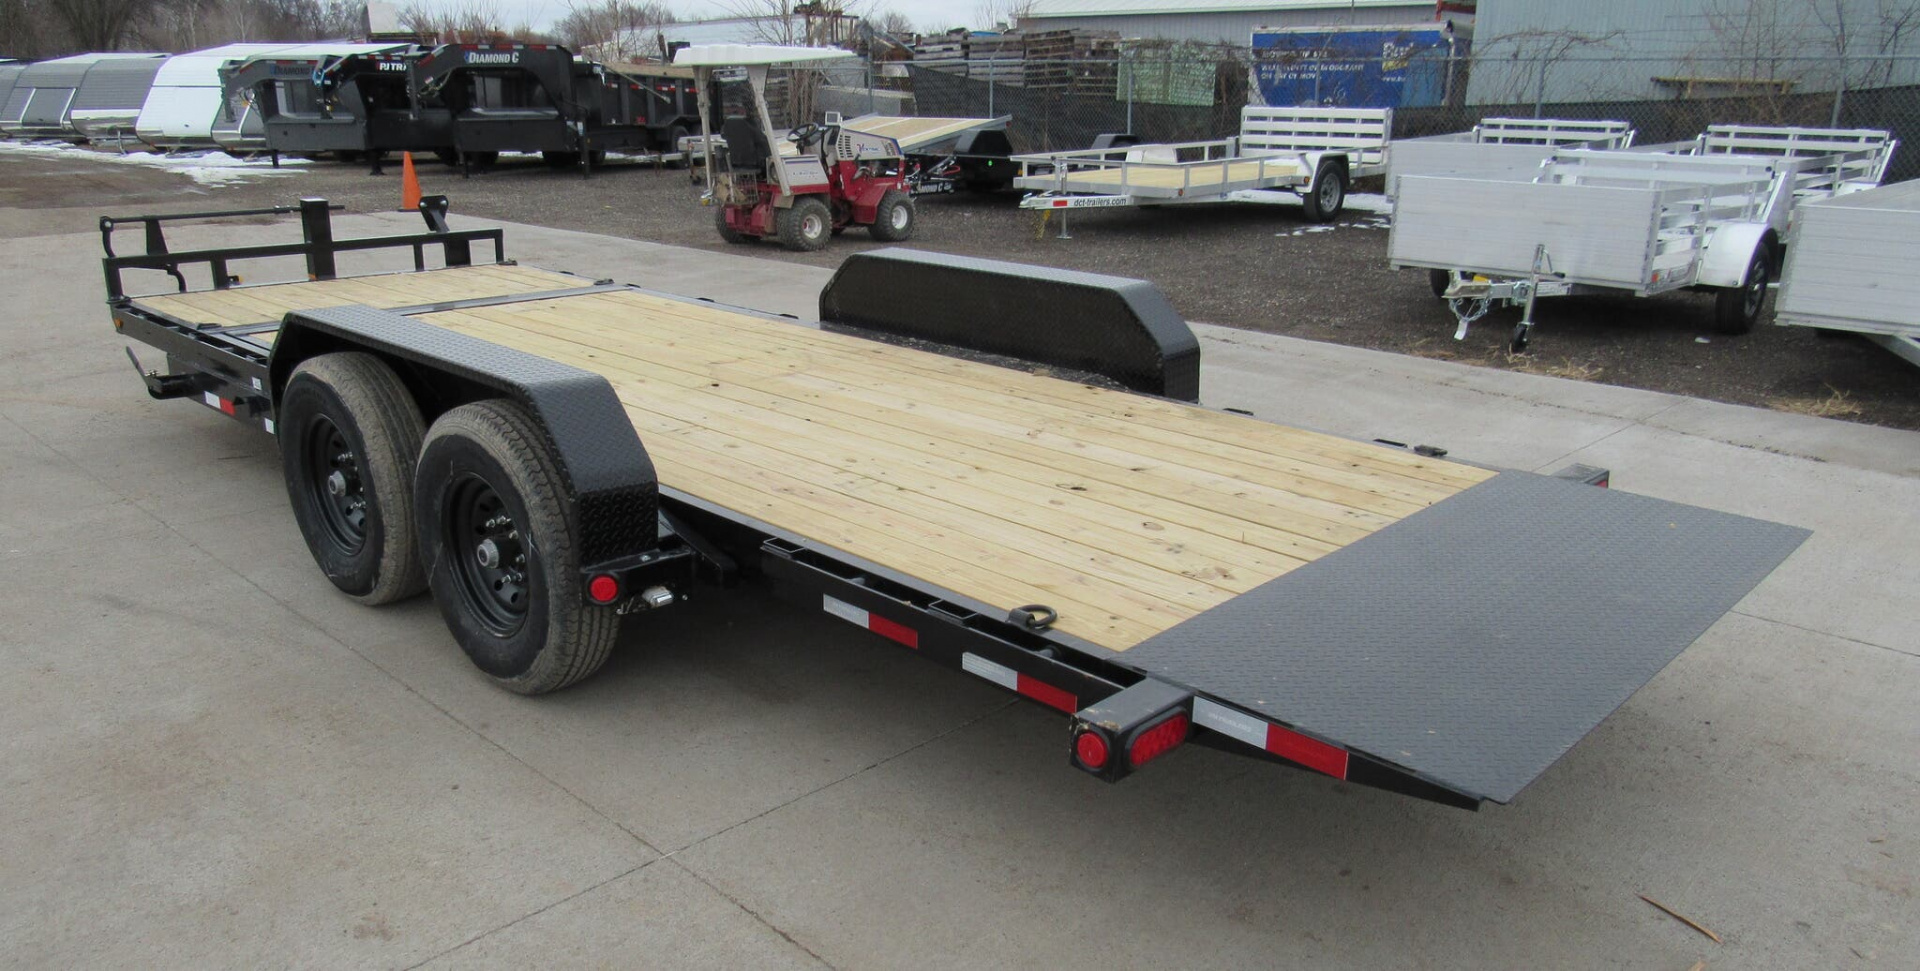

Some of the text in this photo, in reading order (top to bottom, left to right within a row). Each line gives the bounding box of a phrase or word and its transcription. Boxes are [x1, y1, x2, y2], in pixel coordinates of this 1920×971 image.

[469, 52, 519, 64] DIAMOND C
[379, 62, 390, 71] PJ
